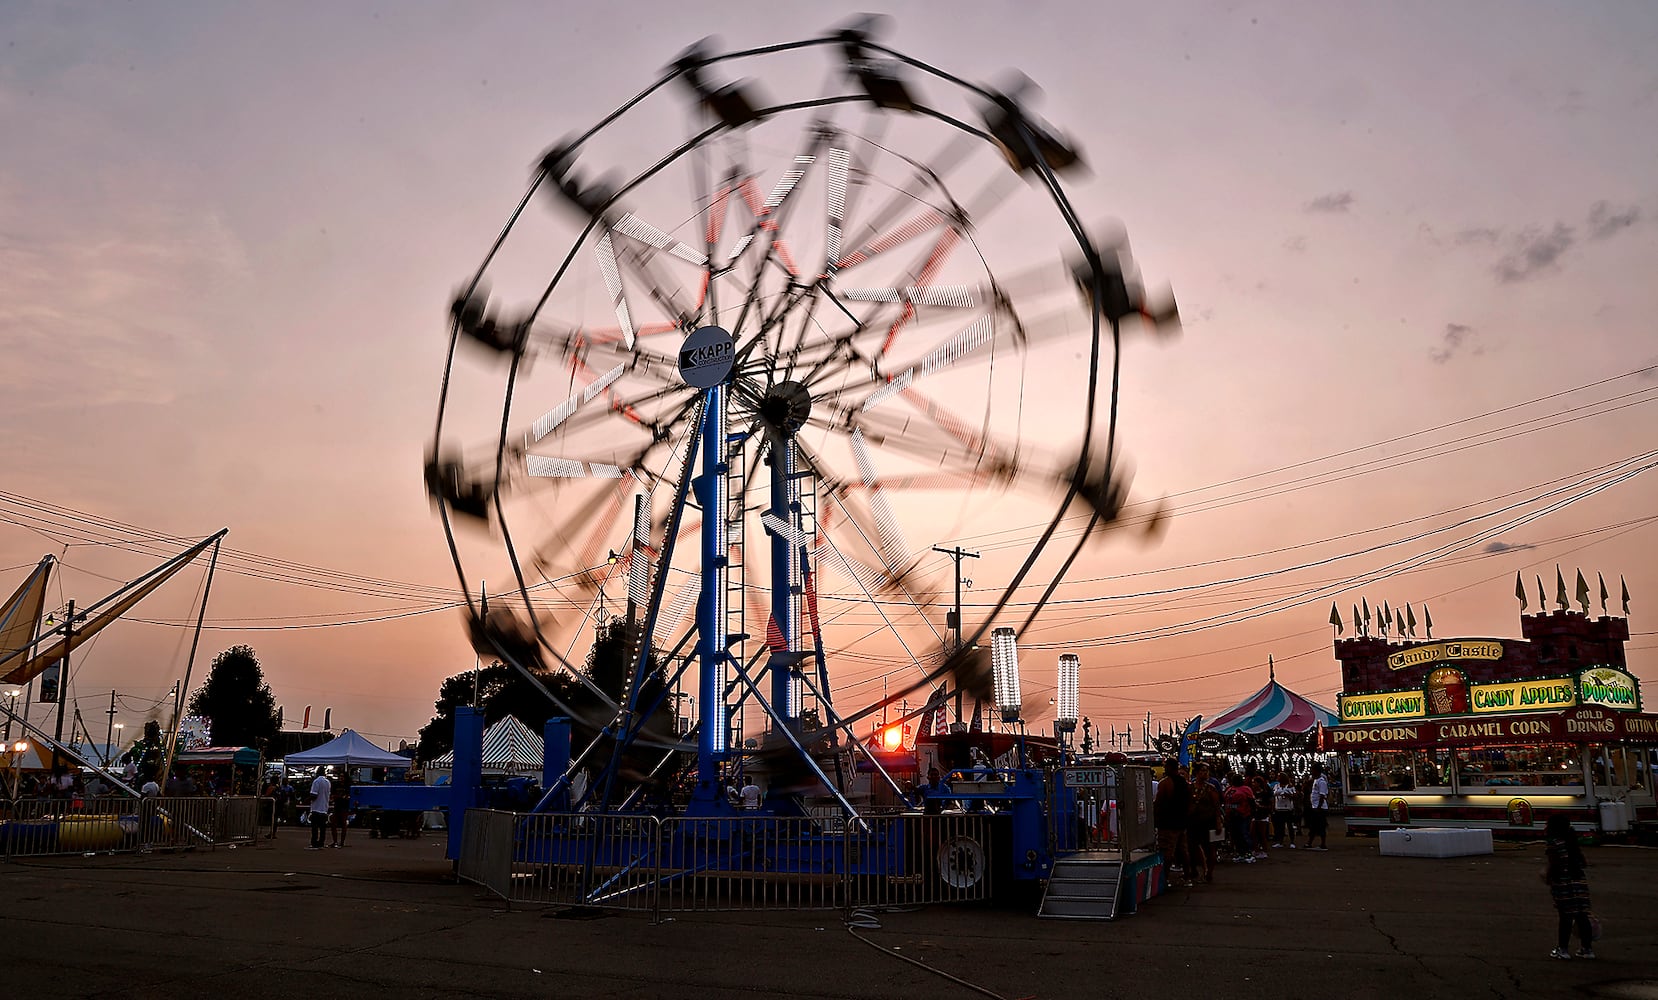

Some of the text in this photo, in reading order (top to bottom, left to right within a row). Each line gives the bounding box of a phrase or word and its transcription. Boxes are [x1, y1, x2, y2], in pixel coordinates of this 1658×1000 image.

[698, 341, 732, 360] KAPP
[1391, 644, 1500, 668] Candy Castle
[1474, 689, 1515, 708] CANDY
[1520, 685, 1573, 705] APPLES
[1582, 681, 1635, 704] POPCORN
[1344, 700, 1384, 717] COTTON
[1386, 696, 1421, 714] CANDY
[1440, 721, 1551, 738] CARAMEL CORN
[1566, 718, 1615, 733] DRINKS
[1625, 718, 1654, 733] COTTON
[1333, 728, 1418, 743] POPCORN
[1076, 772, 1101, 783] EXIT
